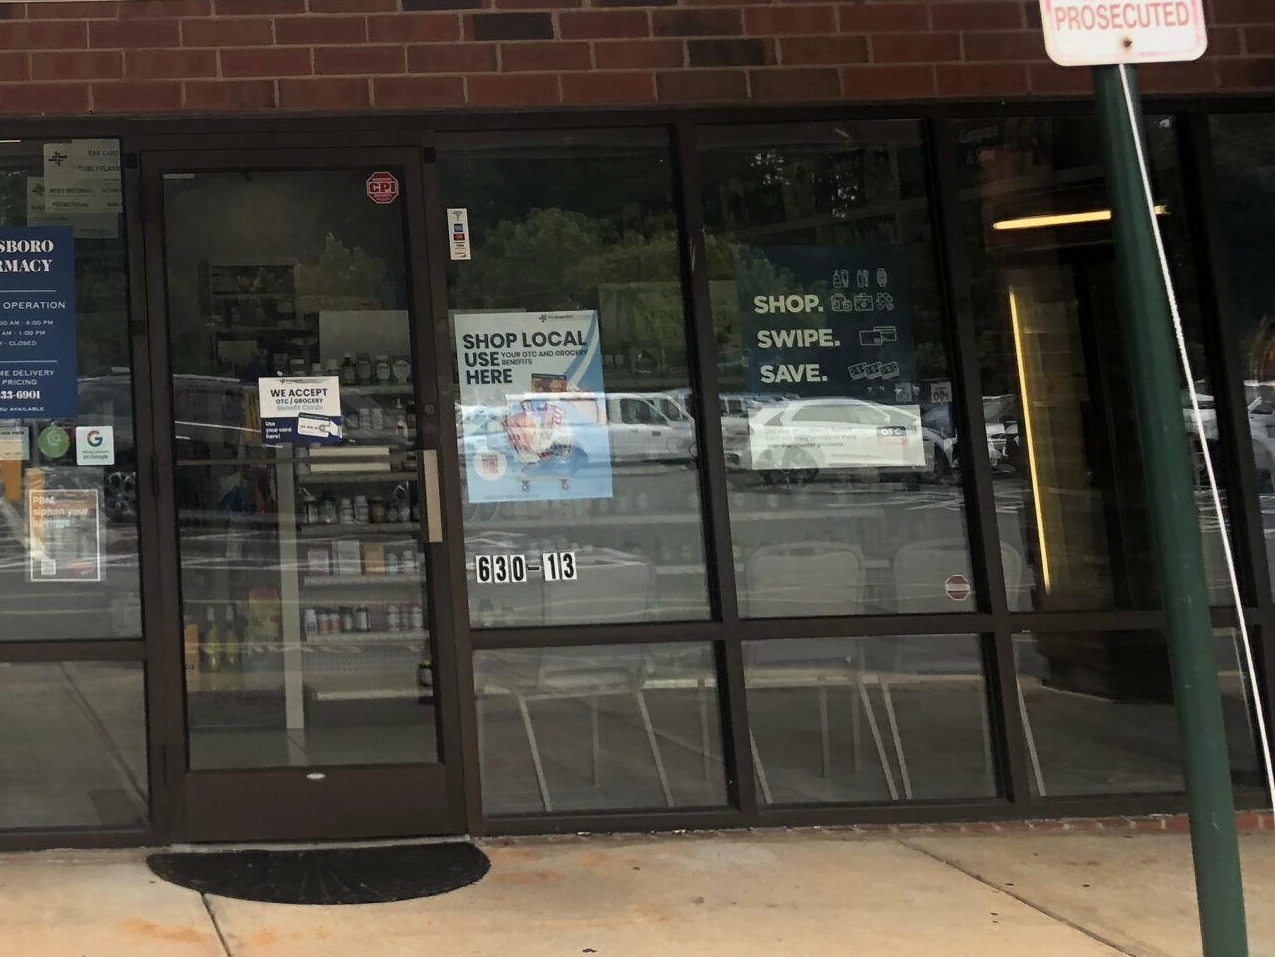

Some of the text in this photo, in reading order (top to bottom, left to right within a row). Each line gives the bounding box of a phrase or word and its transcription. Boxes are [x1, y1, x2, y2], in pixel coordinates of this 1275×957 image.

[1054, 1, 1190, 31] PROSECUTED
[368, 182, 397, 194] CPI
[3, 301, 66, 310] OPERATION
[753, 294, 824, 314] SHOP.
[462, 330, 588, 350] SHOP LOCAL
[757, 328, 841, 348] SWIPE.
[465, 352, 501, 367] USE
[556, 349, 588, 357] GROCERY
[466, 369, 513, 385] HERE
[760, 364, 828, 383] SAVE.
[270, 388, 328, 397] WE ACCEPT
[880, 427, 902, 435] OTC
[67, 508, 88, 517] your
[478, 553, 574, 581] 630-13
